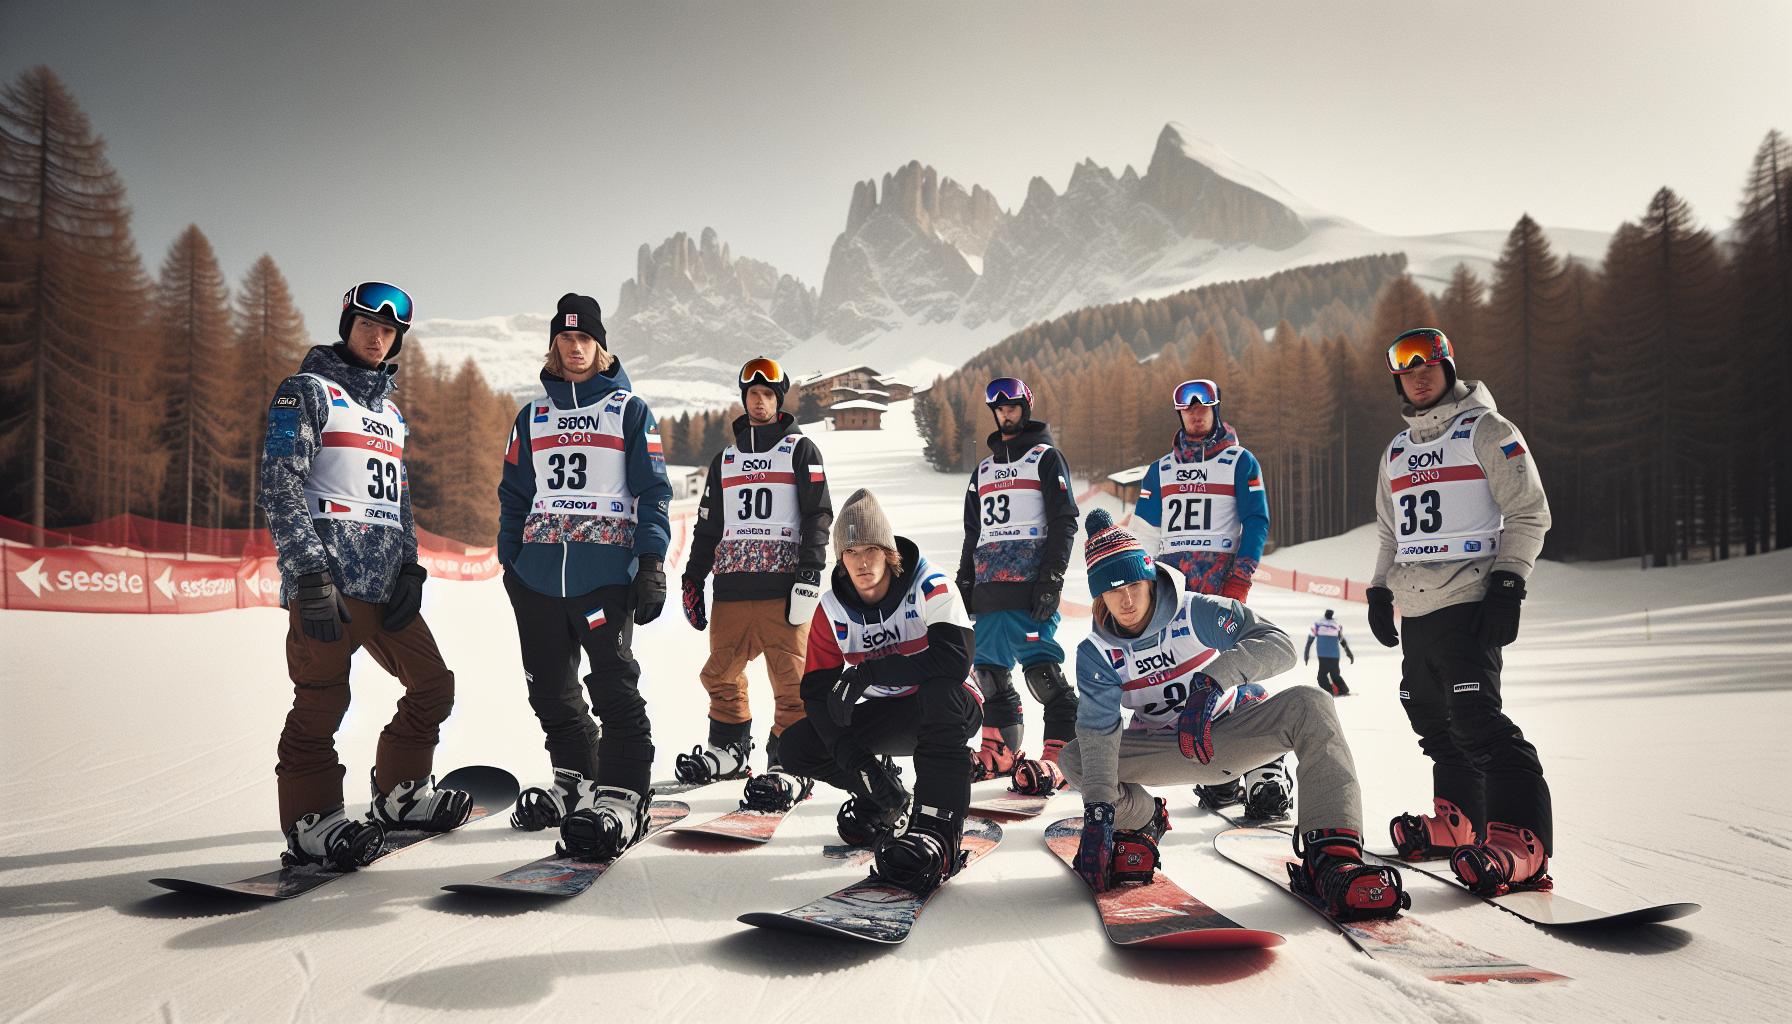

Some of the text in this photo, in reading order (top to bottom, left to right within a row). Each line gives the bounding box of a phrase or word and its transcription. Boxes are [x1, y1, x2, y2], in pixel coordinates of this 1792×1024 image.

[366, 457, 399, 503] 33
[547, 453, 587, 490] 33
[737, 487, 773, 521] 30
[983, 493, 1011, 527] 33
[1168, 498, 1212, 532] 2EI
[1400, 490, 1443, 536] 33
